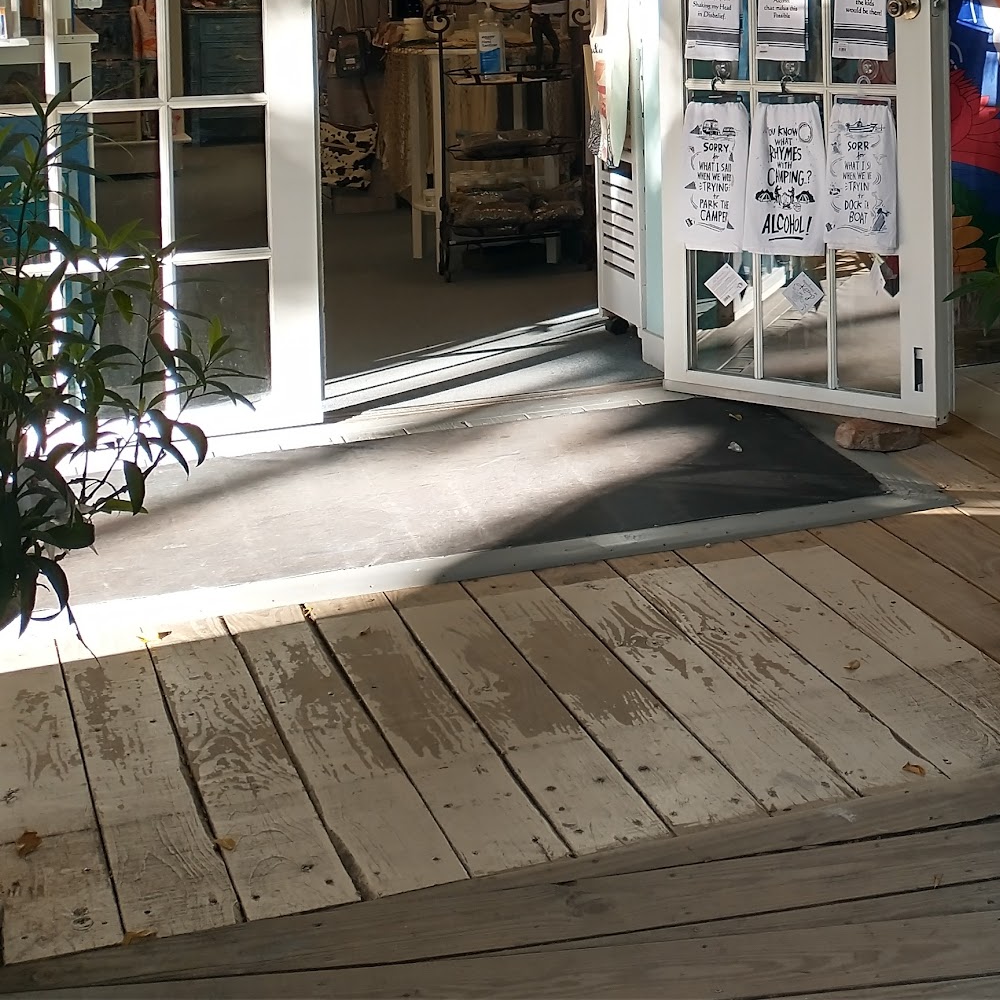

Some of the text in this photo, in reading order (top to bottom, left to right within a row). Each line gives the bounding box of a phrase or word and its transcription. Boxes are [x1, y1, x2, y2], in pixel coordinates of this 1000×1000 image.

[693, 1, 711, 10] Shaking
[778, 126, 798, 136] KNOW
[703, 142, 730, 152] SORRY
[848, 141, 869, 152] SORR
[769, 144, 802, 162] RHYMES
[856, 152, 866, 160] for
[698, 161, 714, 172] WHAT
[844, 161, 860, 170] WHAT
[698, 172, 710, 180] WHEN
[712, 172, 720, 180] WE
[843, 172, 856, 180] WHEN
[857, 172, 866, 180] WE
[704, 182, 729, 192] TRYING
[849, 182, 870, 192] TRYIN
[700, 199, 730, 210] PARK THE
[845, 200, 862, 210] DOCK
[849, 211, 868, 224] BOAT
[762, 213, 812, 236] ALCOHOL!
